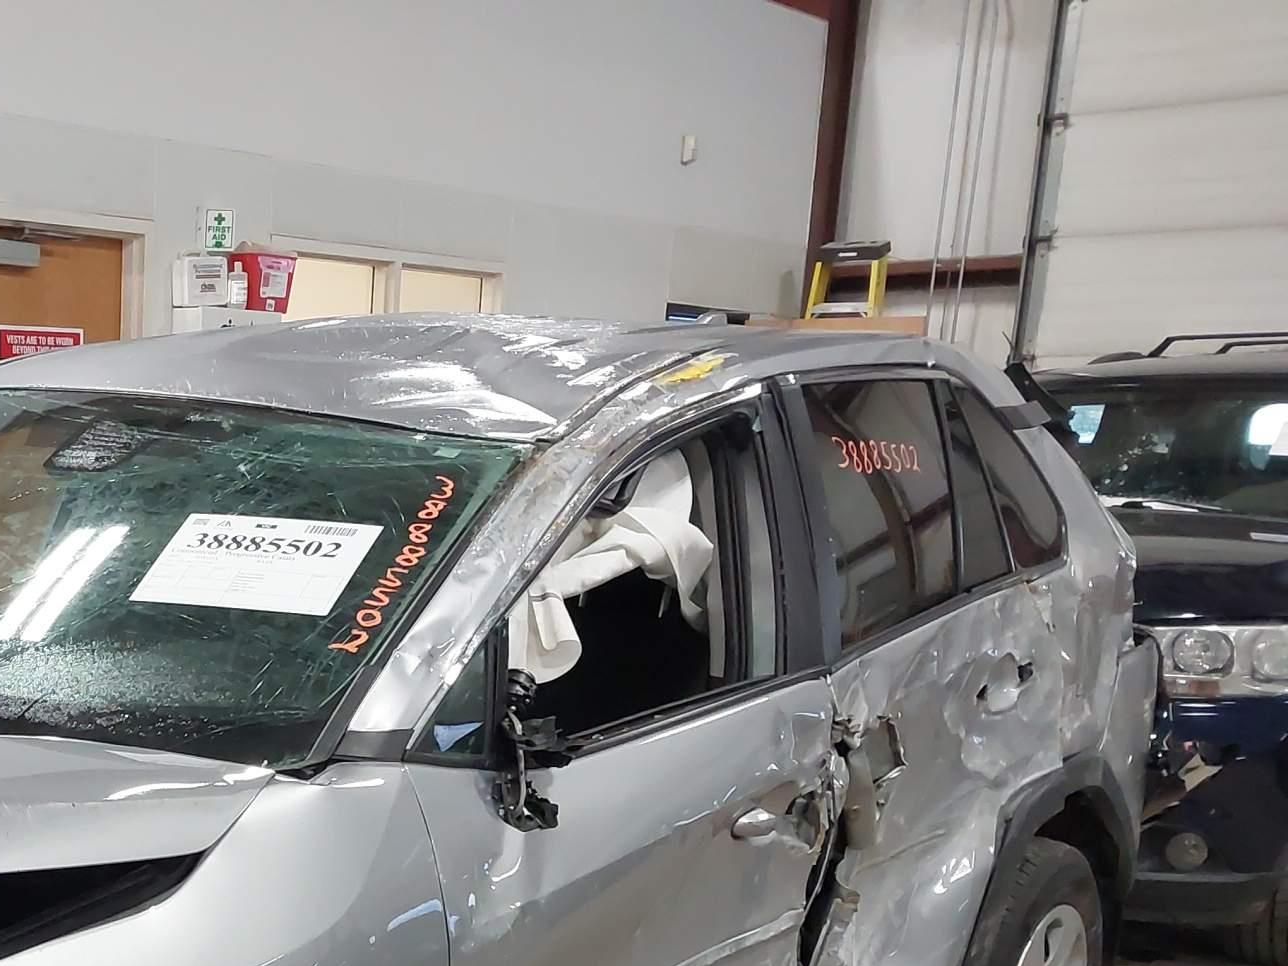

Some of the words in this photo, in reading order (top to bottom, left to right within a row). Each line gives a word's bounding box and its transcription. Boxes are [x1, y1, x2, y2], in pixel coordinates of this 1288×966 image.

[6, 334, 25, 344] VESTS
[26, 335, 38, 345] ARE
[39, 336, 46, 345] TO
[47, 337, 55, 345] BE
[56, 337, 74, 346] WORN
[12, 345, 36, 354] BEYOND
[831, 436, 921, 475] 38885502
[186, 532, 342, 559] 38885502
[328, 475, 456, 654] 38885502
